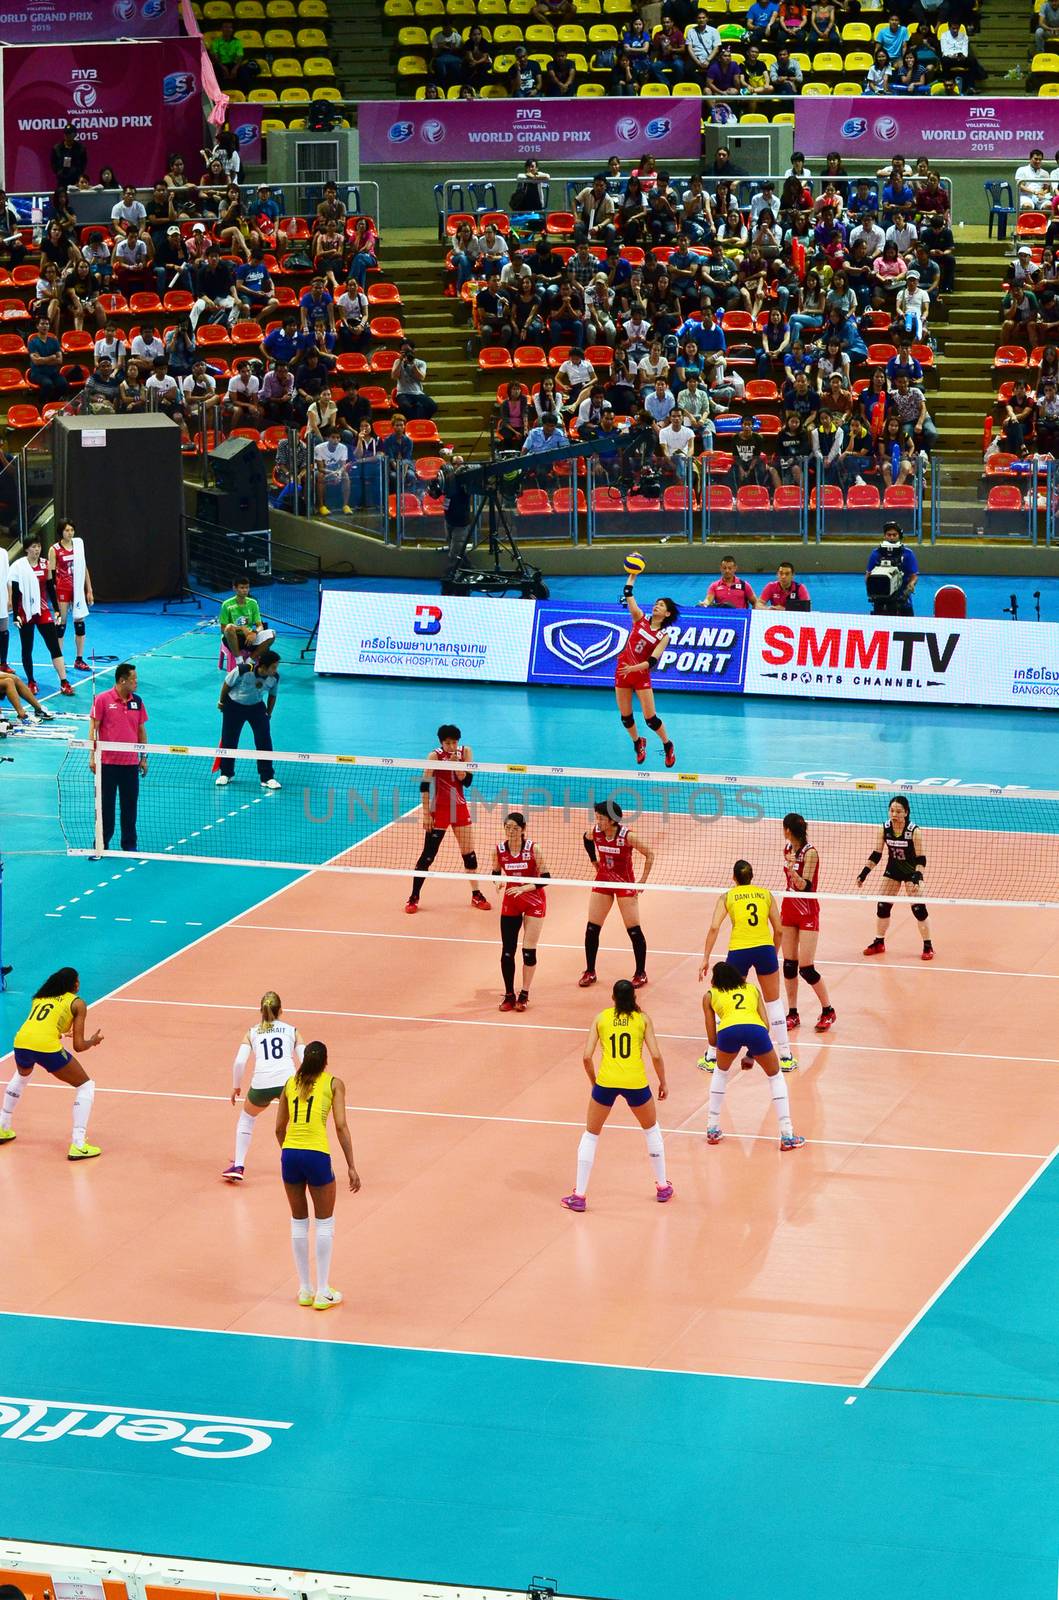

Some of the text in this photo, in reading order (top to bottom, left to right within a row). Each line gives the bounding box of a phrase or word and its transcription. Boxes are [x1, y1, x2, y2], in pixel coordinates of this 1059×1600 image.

[0, 12, 93, 23] ORLD GRAND PRIX
[31, 24, 52, 32] 2015
[71, 69, 97, 79] FIVB
[516, 109, 542, 118] FIVB
[969, 108, 995, 117] FIVB
[18, 116, 153, 131] WORLD GRAND PRIX
[73, 132, 99, 141] 2015
[468, 131, 592, 143] WORLD GRAND PRIX
[921, 130, 1045, 141] WORLD GRAND PRIX
[518, 145, 542, 153] 2015
[971, 143, 995, 151] 2015
[664, 626, 736, 648] RAND
[761, 624, 961, 674] SMMTV
[358, 653, 485, 668] BANGKOK HOSPITAL GROUP
[656, 650, 732, 674] PORT
[853, 676, 923, 688] CHANNEL
[746, 902, 759, 927] 3
[732, 993, 746, 1010] 2
[29, 1003, 55, 1021] 16
[613, 1018, 629, 1027] GABI
[260, 1037, 284, 1061] 18
[609, 1032, 632, 1060] 10
[293, 1095, 315, 1124] 11
